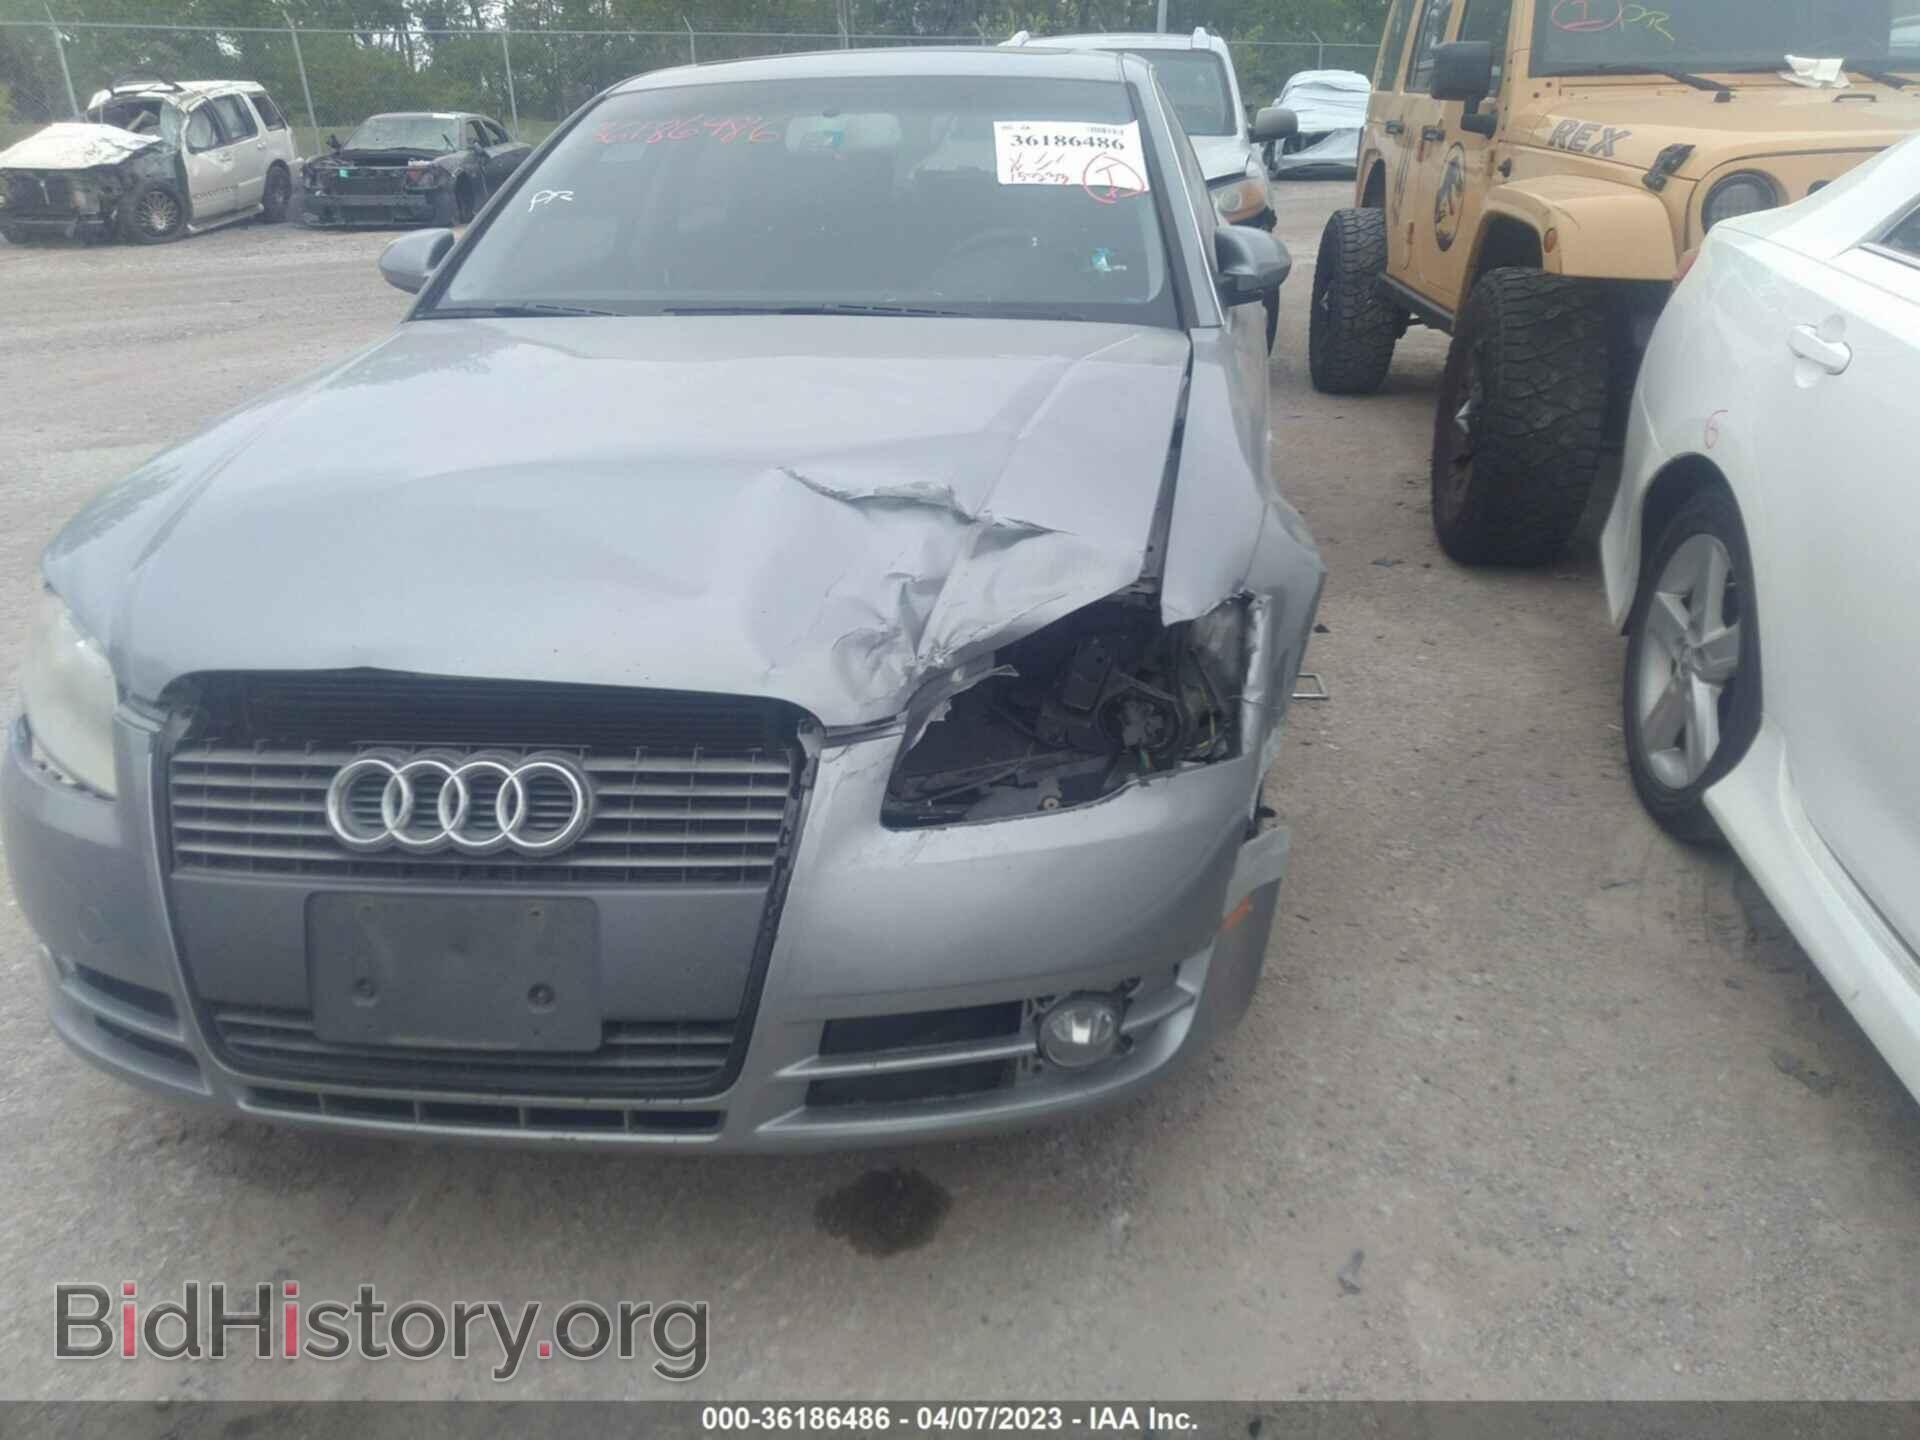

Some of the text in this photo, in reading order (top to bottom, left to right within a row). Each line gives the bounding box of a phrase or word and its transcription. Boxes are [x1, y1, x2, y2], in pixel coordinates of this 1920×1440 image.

[1010, 134, 1126, 151] 36186486
[1547, 119, 1633, 157] REX
[1703, 409, 1729, 450] 6
